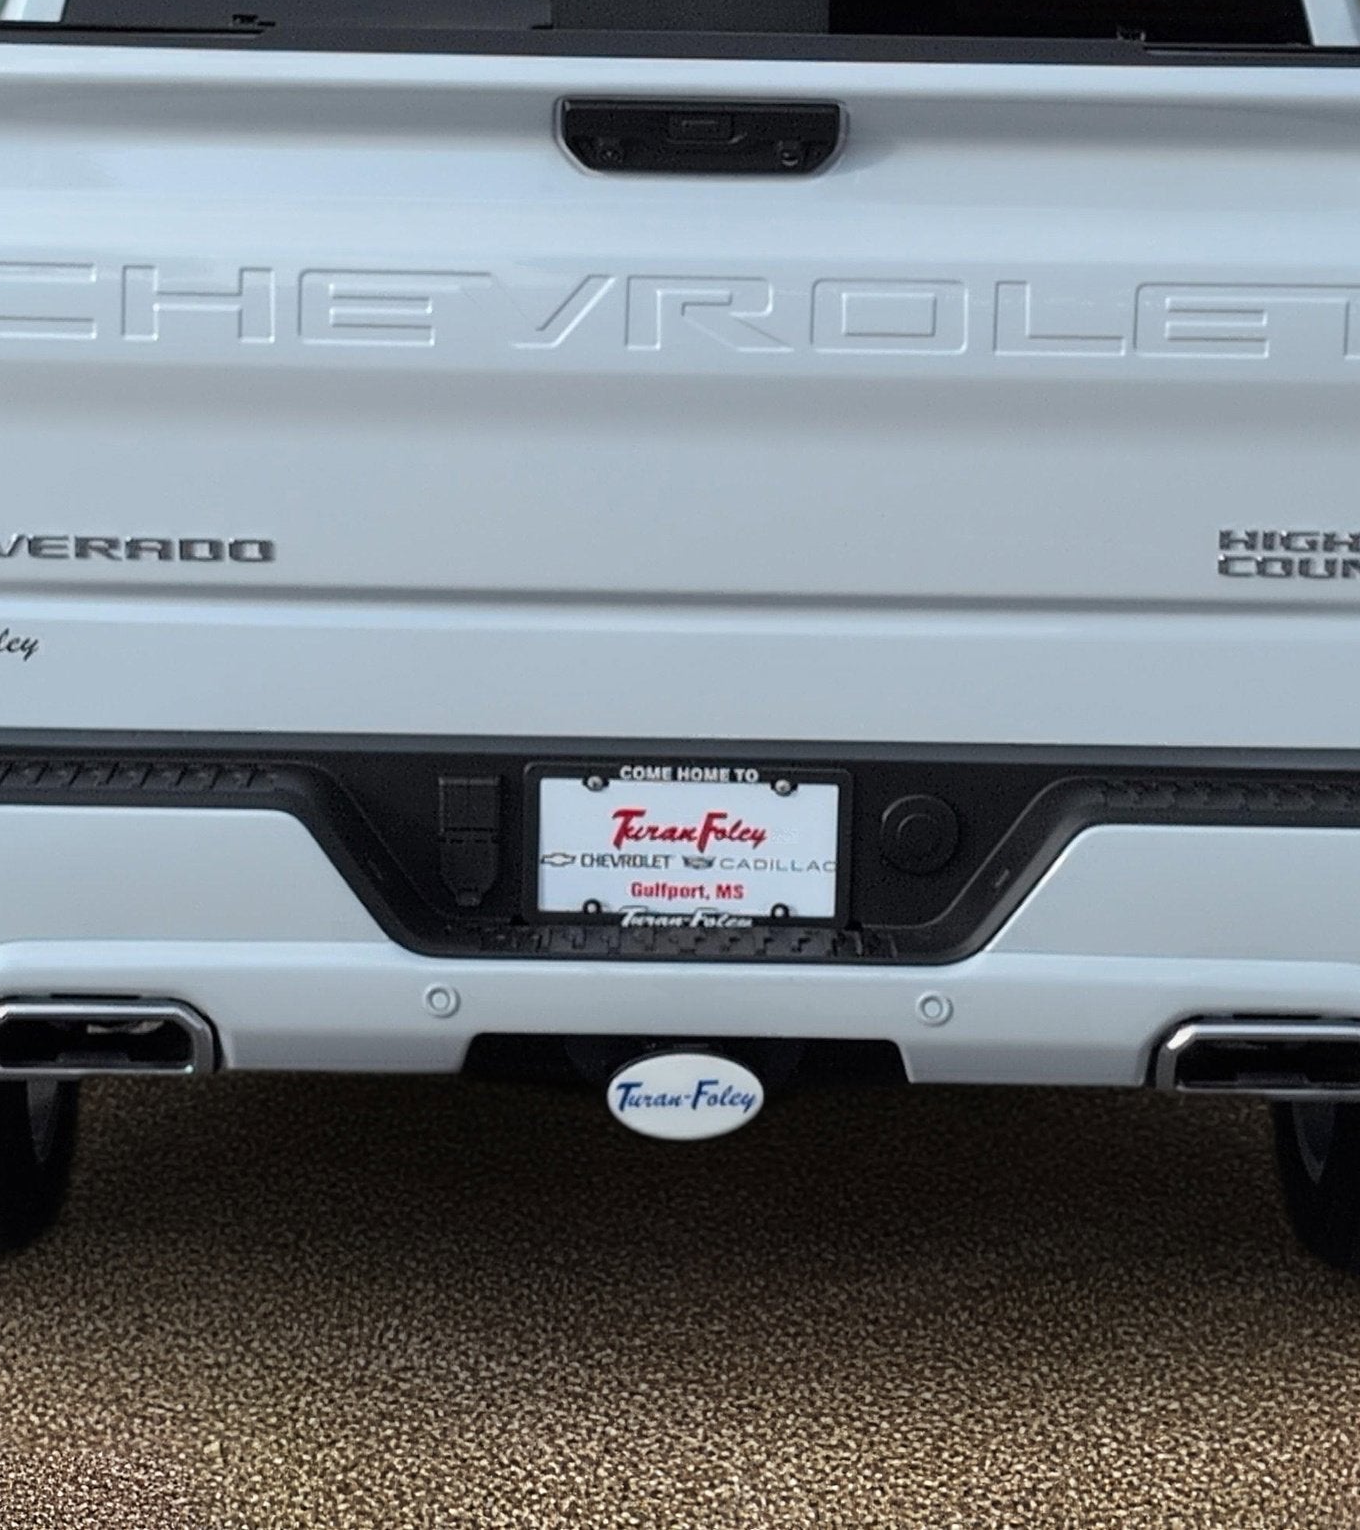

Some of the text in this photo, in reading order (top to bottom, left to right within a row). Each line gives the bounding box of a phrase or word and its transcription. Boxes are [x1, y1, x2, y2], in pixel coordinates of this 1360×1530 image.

[619, 765, 760, 783] COME HOME TO
[580, 852, 838, 874] CHEVROLET CADILLAC
[631, 881, 745, 901] Gulfport, MS
[616, 1079, 756, 1114] Turan-Foley
